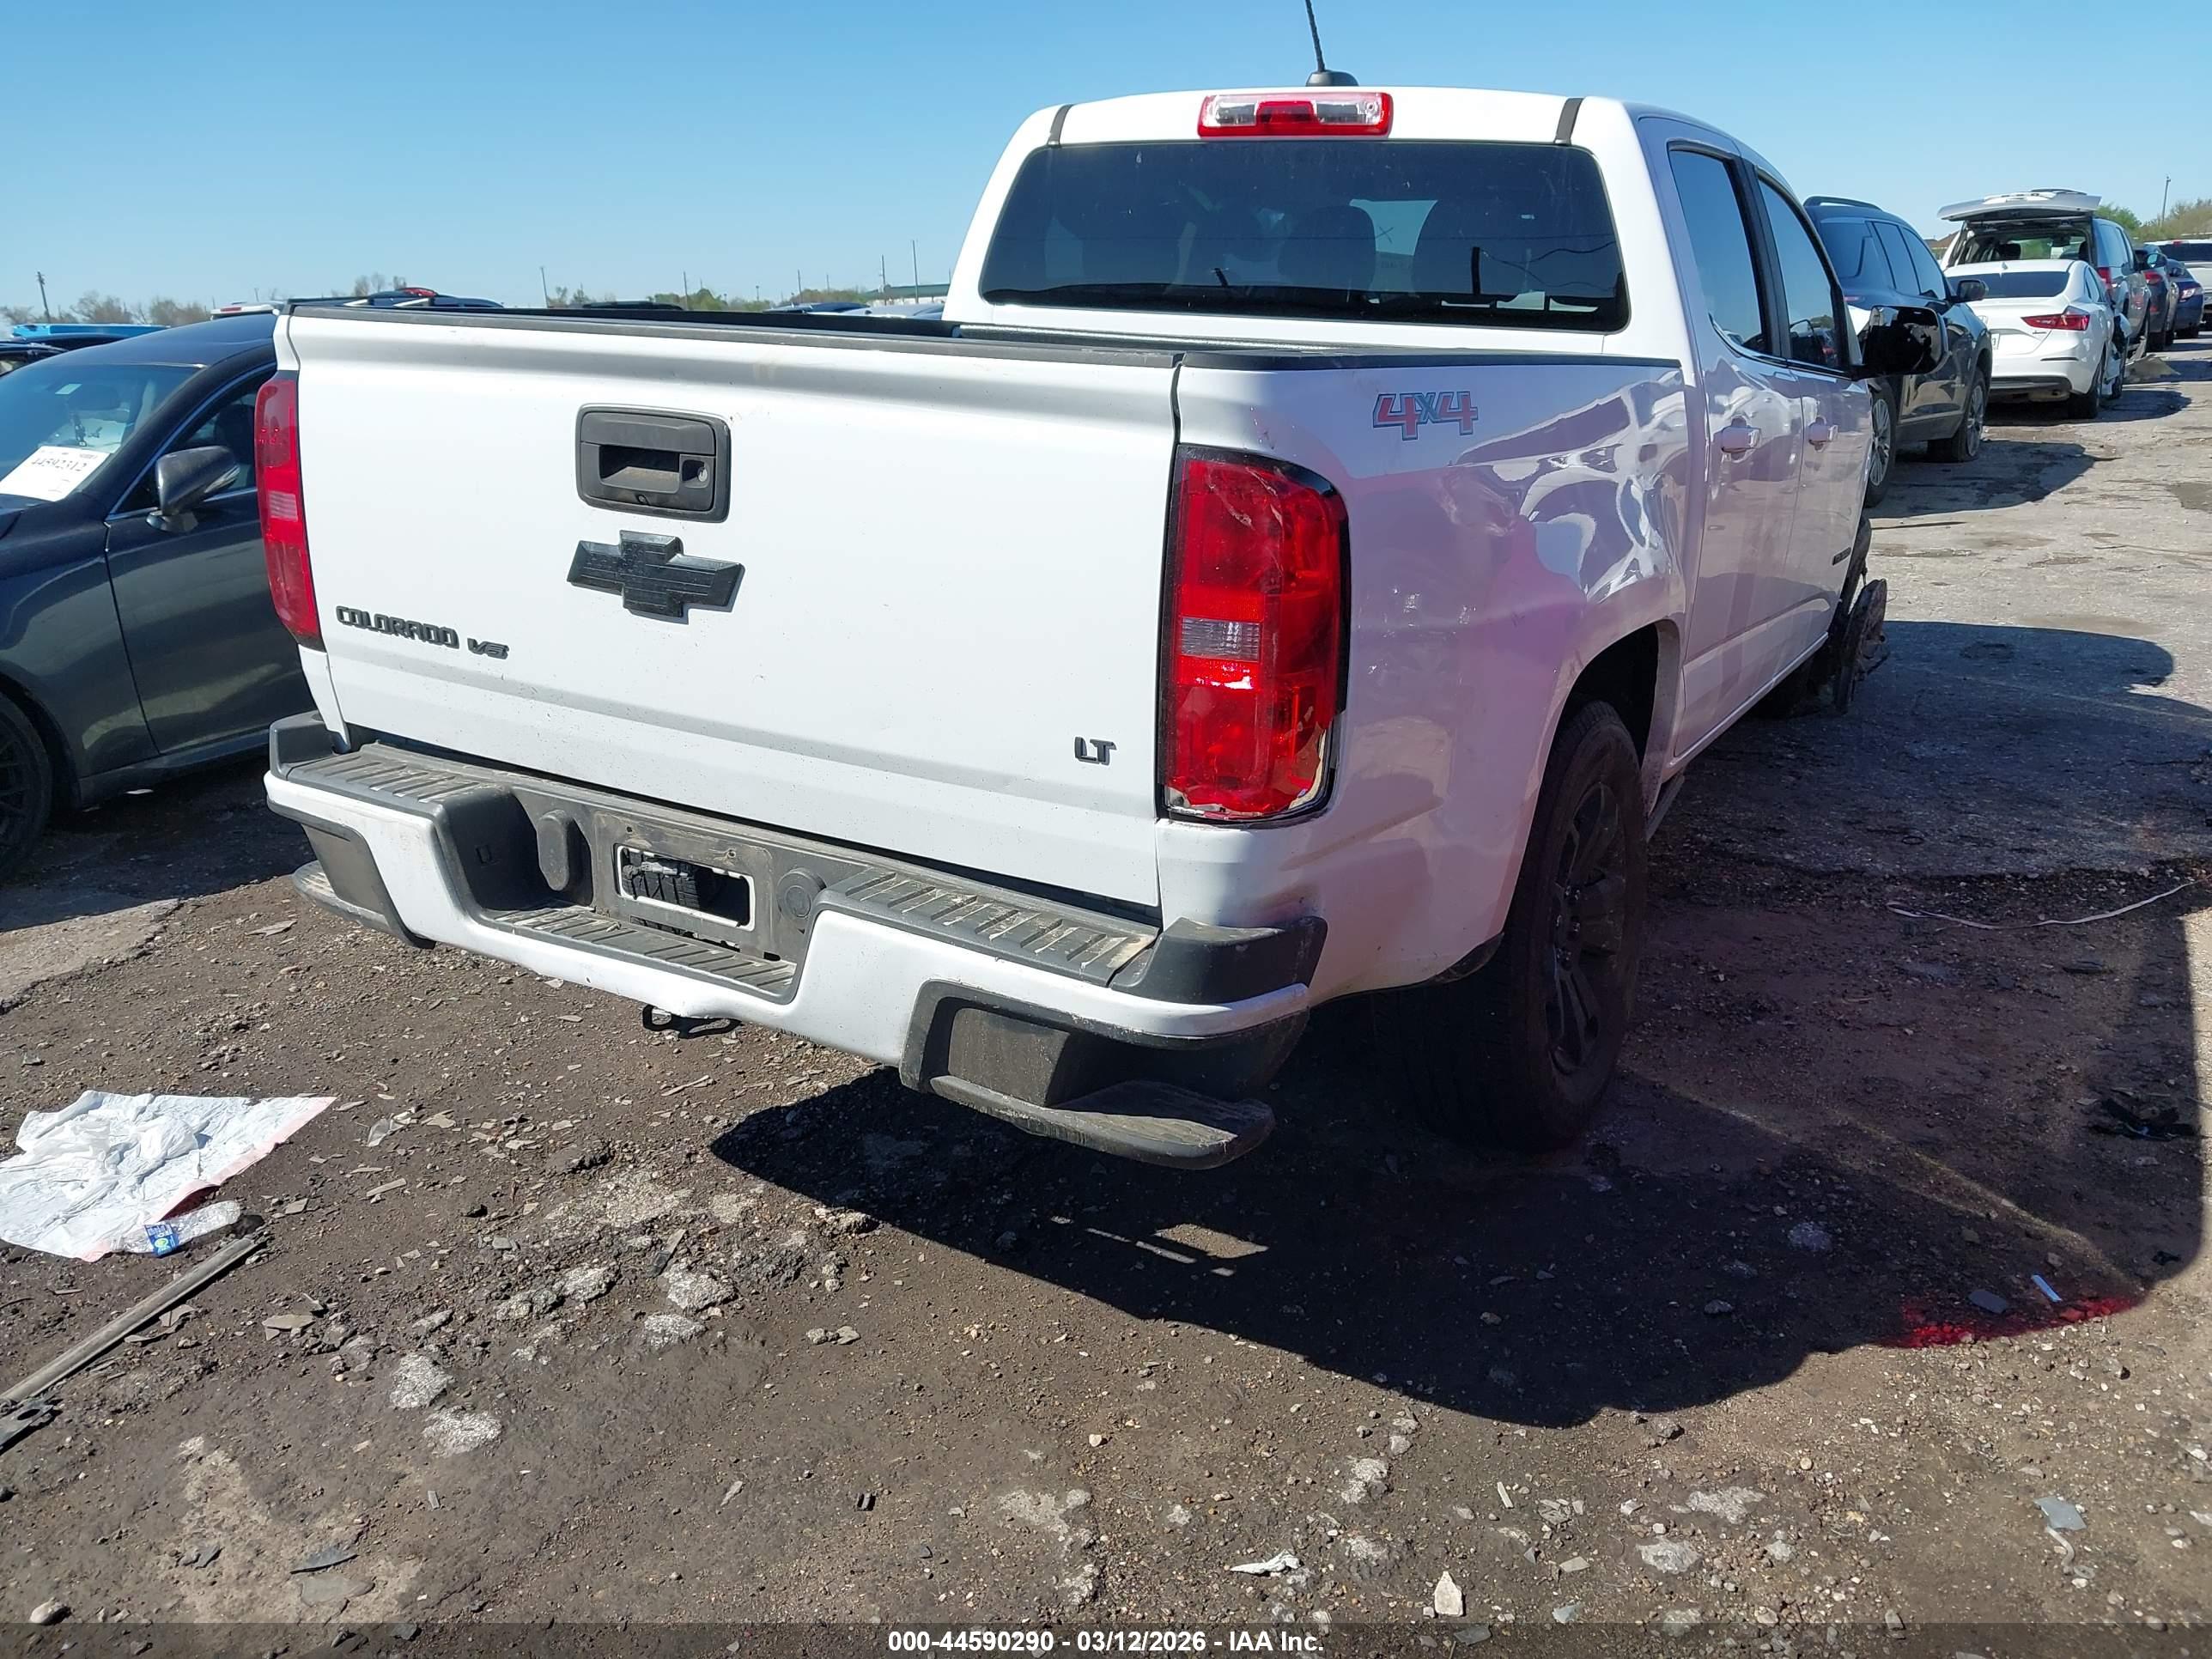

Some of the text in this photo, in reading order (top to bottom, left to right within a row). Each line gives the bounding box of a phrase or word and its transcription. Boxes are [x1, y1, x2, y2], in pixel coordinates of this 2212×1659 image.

[336, 605, 510, 660] COLORADO V6
[1074, 736, 1117, 766] LT
